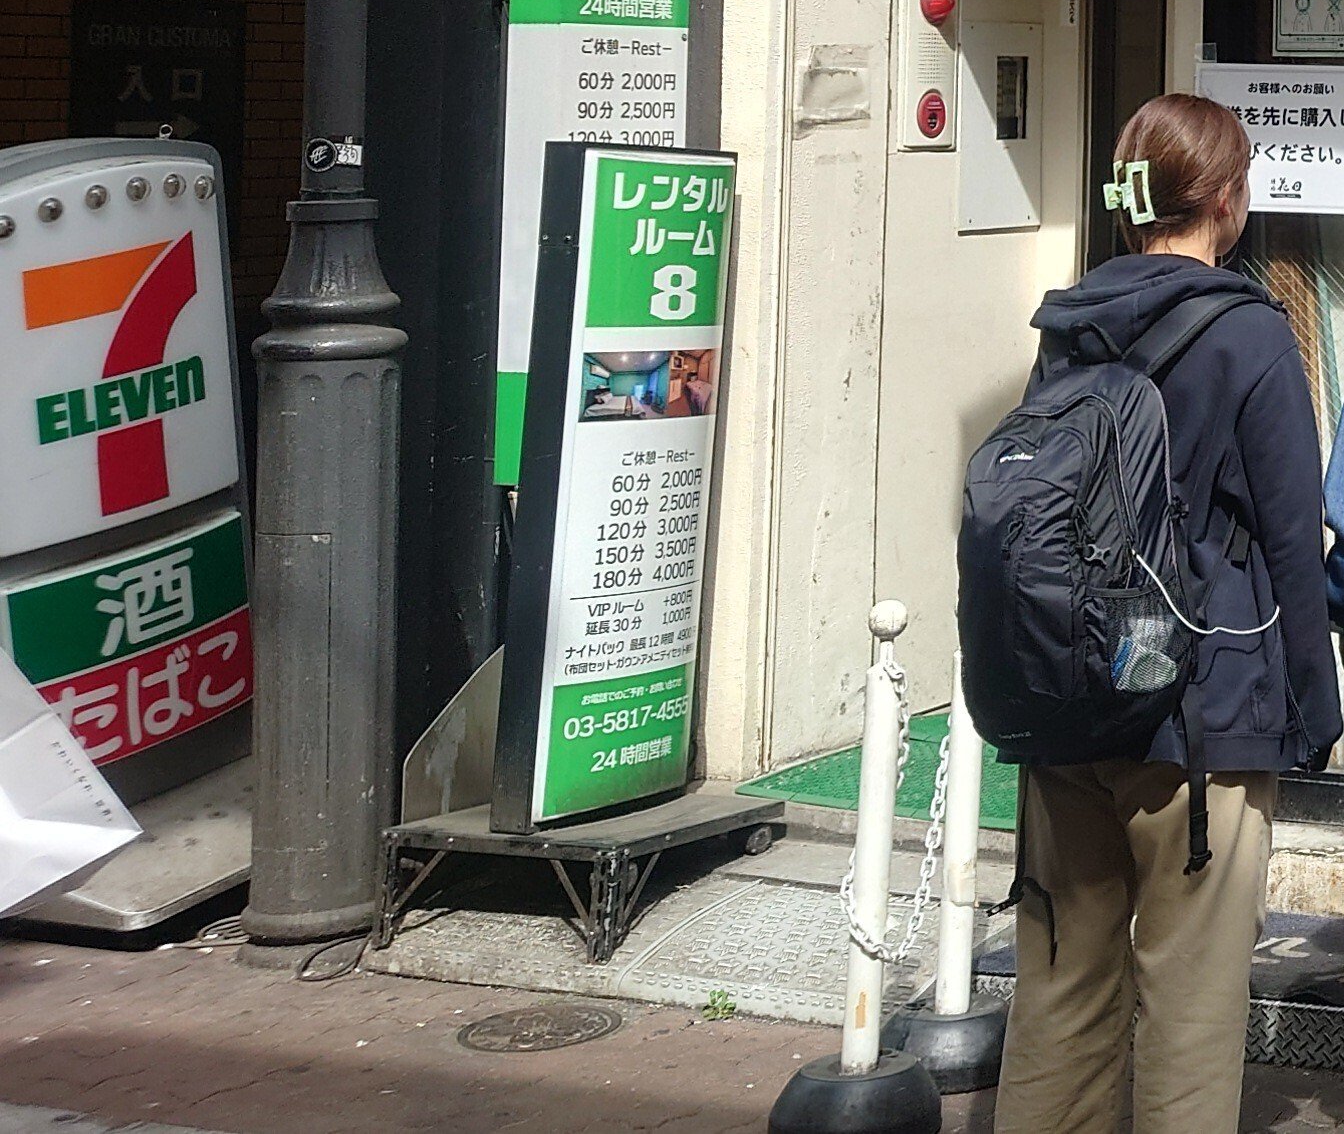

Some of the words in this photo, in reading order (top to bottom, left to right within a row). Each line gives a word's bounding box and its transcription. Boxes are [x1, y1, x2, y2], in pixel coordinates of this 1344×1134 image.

[117, 65, 204, 102] 入口
[578, 72, 614, 90] 60分
[621, 73, 677, 91] 2,000円
[1247, 81, 1335, 96] お客様へのお願い
[577, 102, 613, 120] 90分
[620, 102, 675, 120] 2,500円
[613, 172, 729, 214] レンタル
[629, 218, 716, 256] ルーム
[650, 264, 697, 320] 8
[612, 473, 651, 493] 60分
[660, 468, 702, 490] 2,000円
[610, 497, 649, 517] 90分
[659, 491, 700, 513] 2,500円
[597, 520, 647, 542] 120分
[657, 514, 699, 536] 3,000円
[595, 543, 645, 566] 150分
[654, 536, 697, 560] 3,500円
[593, 567, 643, 590] 180分
[652, 559, 695, 582] 4,000円
[96, 546, 196, 658] 酒
[52, 633, 247, 762] たばこ
[563, 694, 690, 741] 03-5817-4555
